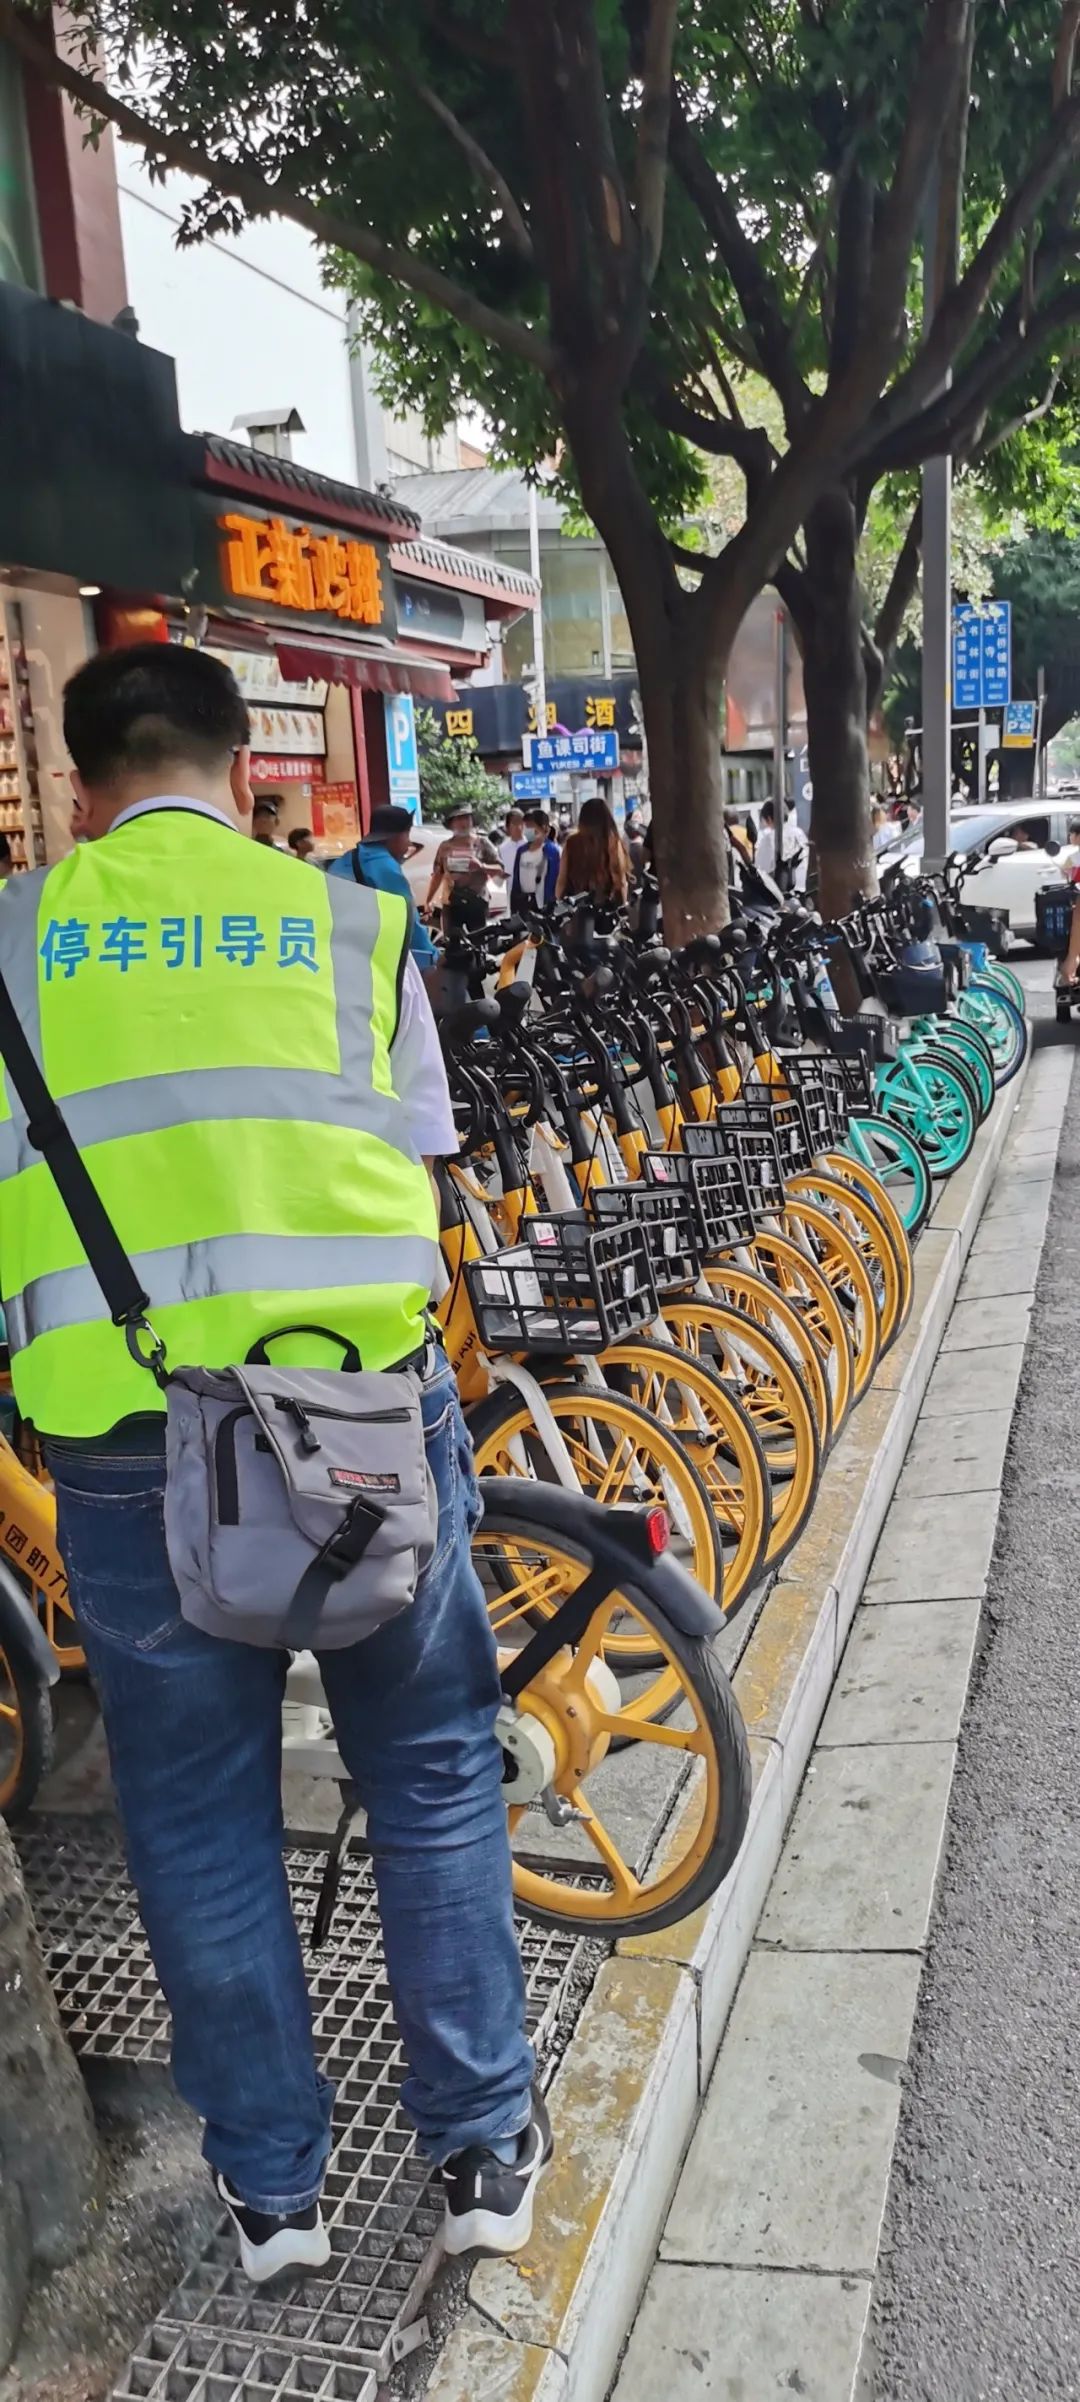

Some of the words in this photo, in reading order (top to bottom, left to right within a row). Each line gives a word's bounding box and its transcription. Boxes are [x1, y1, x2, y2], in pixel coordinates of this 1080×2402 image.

[223, 513, 385, 626] 正新鸡排
[393, 712, 410, 767] P
[445, 709, 473, 736] 四
[537, 736, 606, 759] 鱼课司街
[39, 914, 320, 982] 停车引导员
[0, 1511, 69, 1599] 团助力
